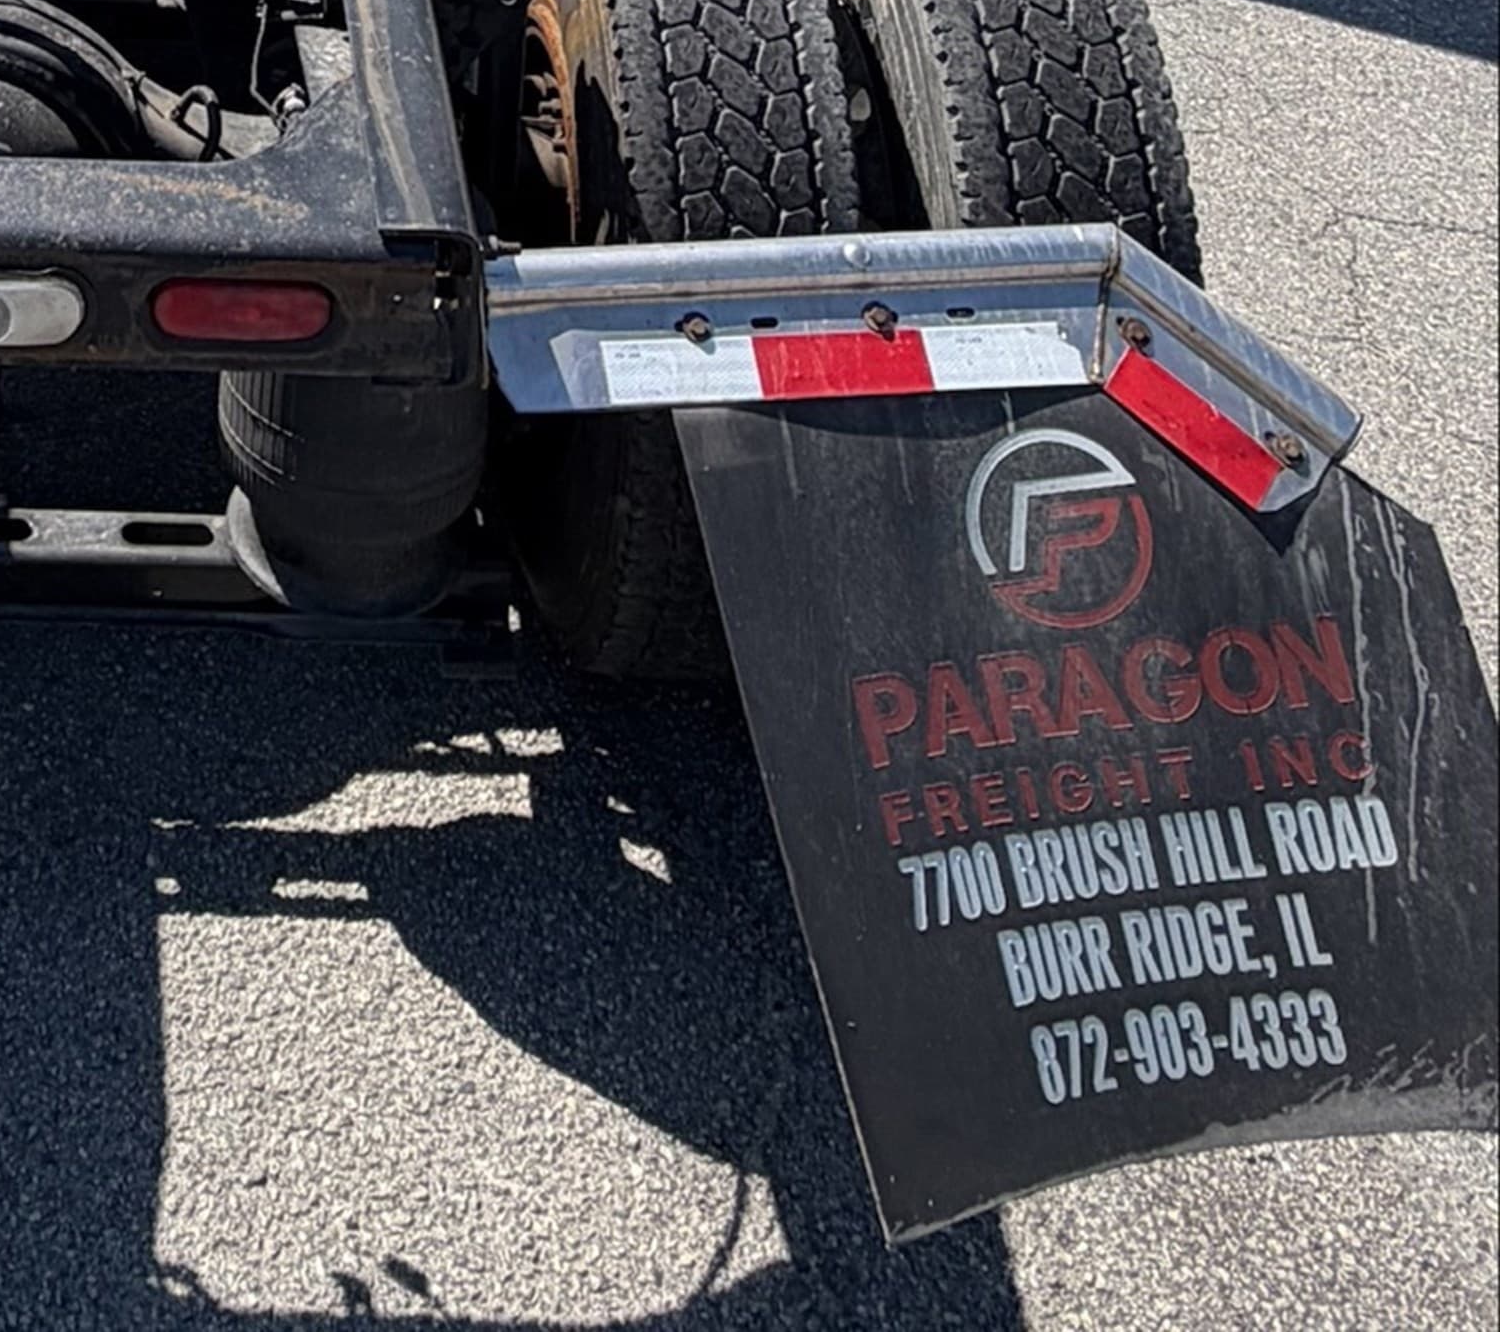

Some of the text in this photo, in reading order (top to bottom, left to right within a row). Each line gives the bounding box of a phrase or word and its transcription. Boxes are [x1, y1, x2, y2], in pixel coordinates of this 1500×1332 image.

[852, 613, 1355, 769] PARAGON
[879, 729, 1375, 846] FREIGHT INC
[899, 794, 1398, 931] 7700 BRUSH HILL ROAD
[999, 892, 1333, 1008] BURR RIDGE, IL
[1030, 988, 1347, 1106] 872-903-4333
